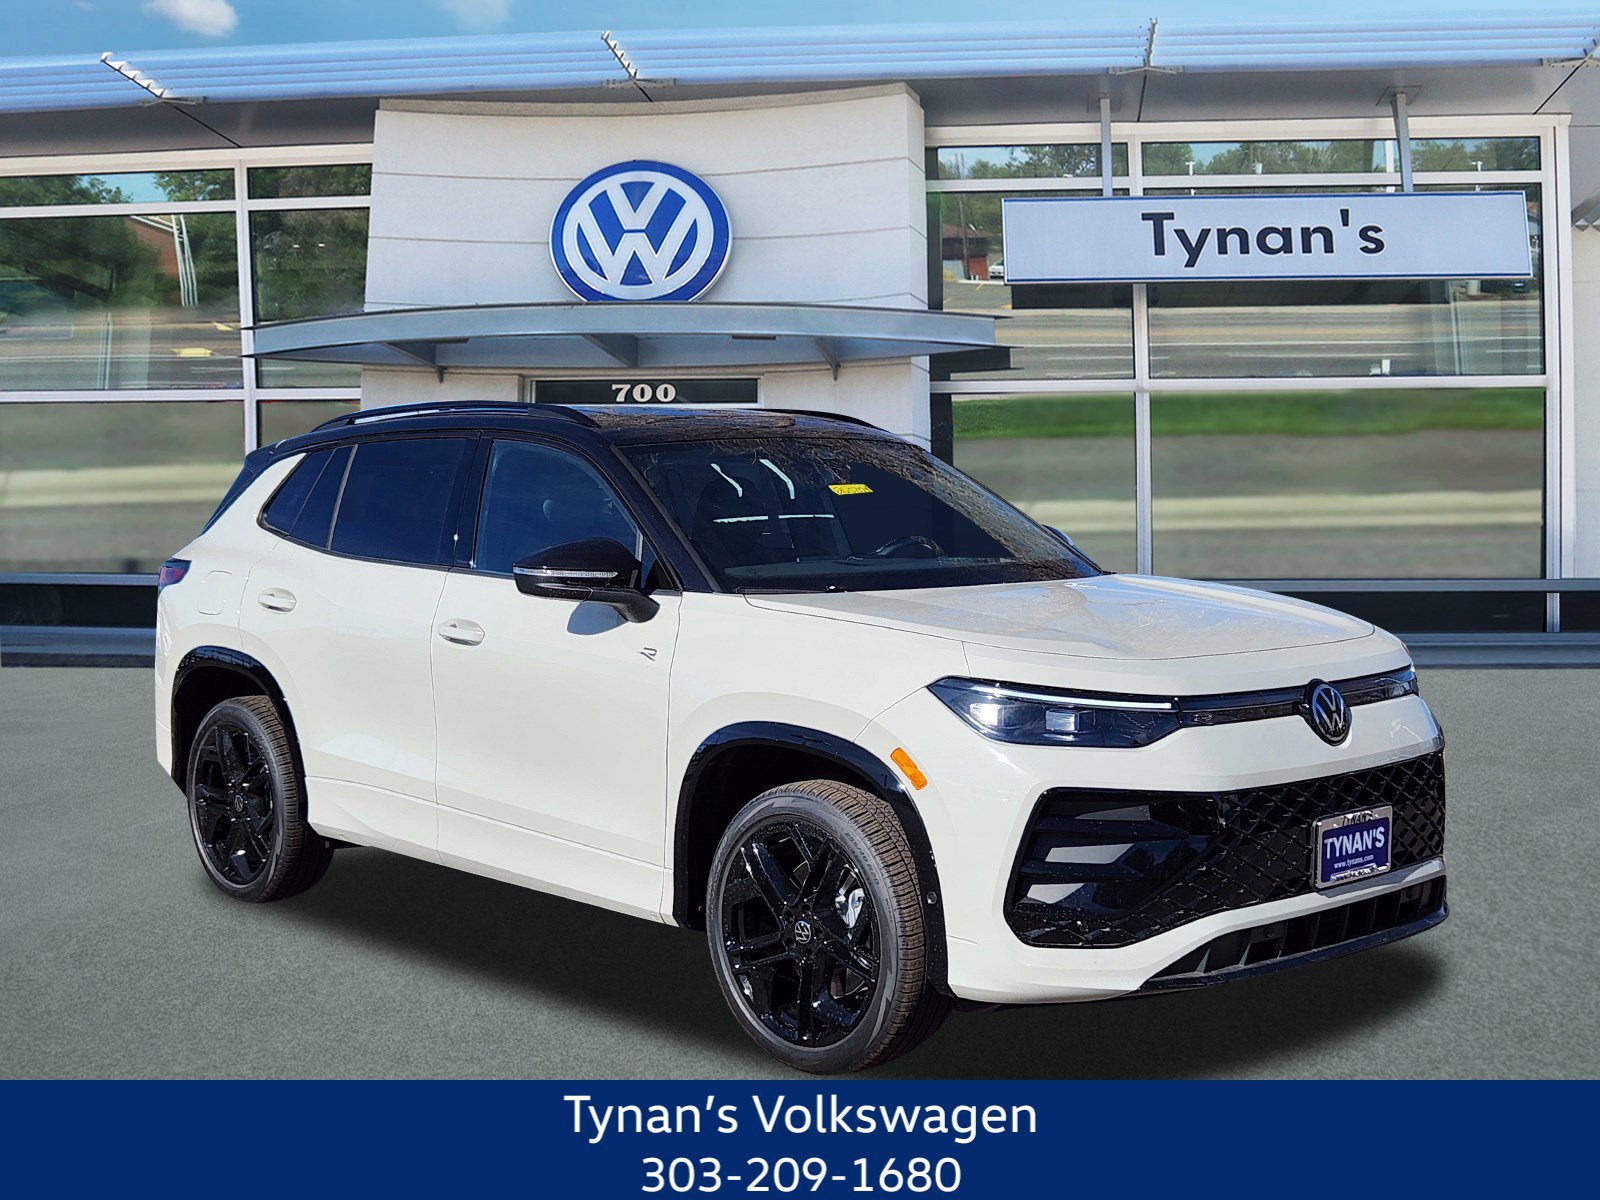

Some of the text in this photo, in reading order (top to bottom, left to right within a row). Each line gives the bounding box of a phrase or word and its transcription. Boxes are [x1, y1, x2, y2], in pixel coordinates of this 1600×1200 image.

[1141, 208, 1385, 268] Tynan's
[611, 383, 676, 403] 700
[1323, 825, 1386, 860] TYNAN'S
[1333, 854, 1375, 870] www.tynans.com
